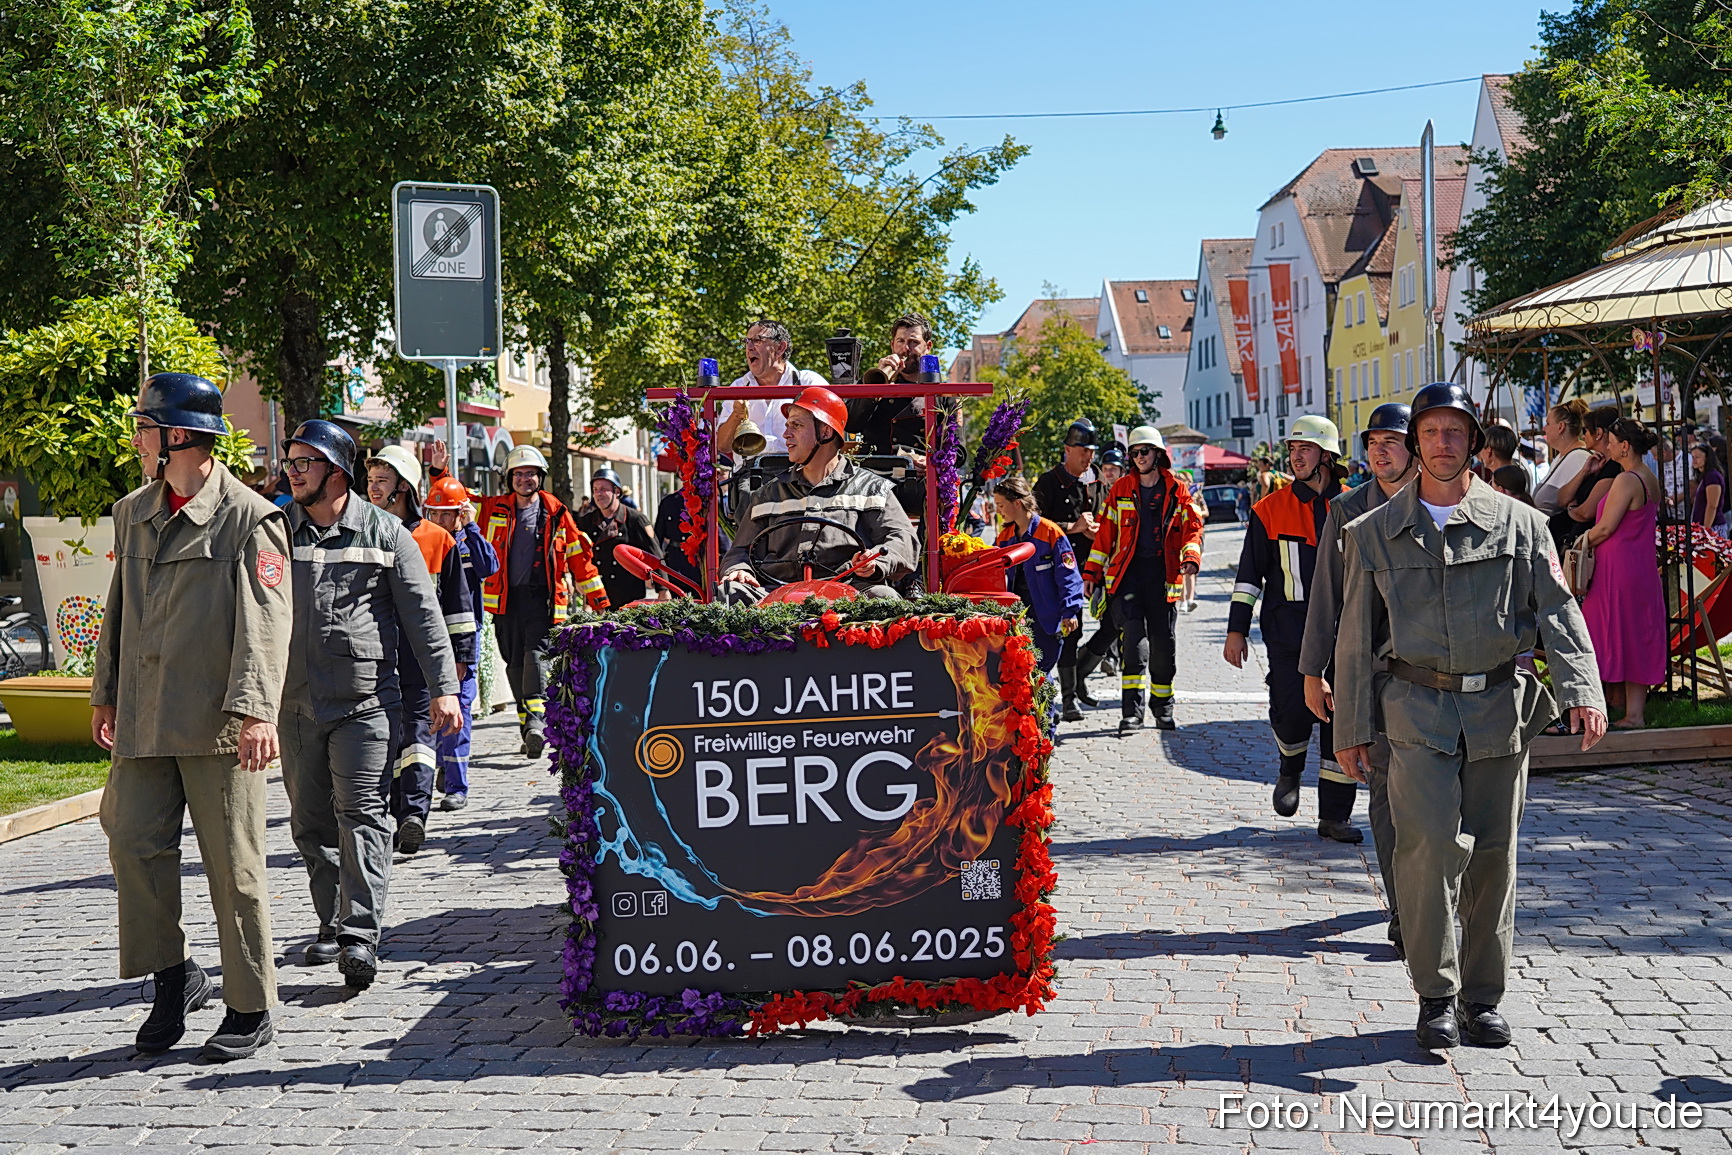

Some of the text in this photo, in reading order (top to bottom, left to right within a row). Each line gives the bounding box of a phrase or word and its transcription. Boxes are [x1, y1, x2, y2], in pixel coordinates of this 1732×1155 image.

[430, 261, 466, 274] ZONE
[1273, 299, 1295, 352] SALE
[691, 671, 915, 719] 150 JAHRE
[694, 726, 915, 753] Freiwillige Feuerwehr
[694, 750, 918, 829] BERG
[614, 939, 735, 976] 06.06.
[787, 926, 1006, 968] 08.06.2025
